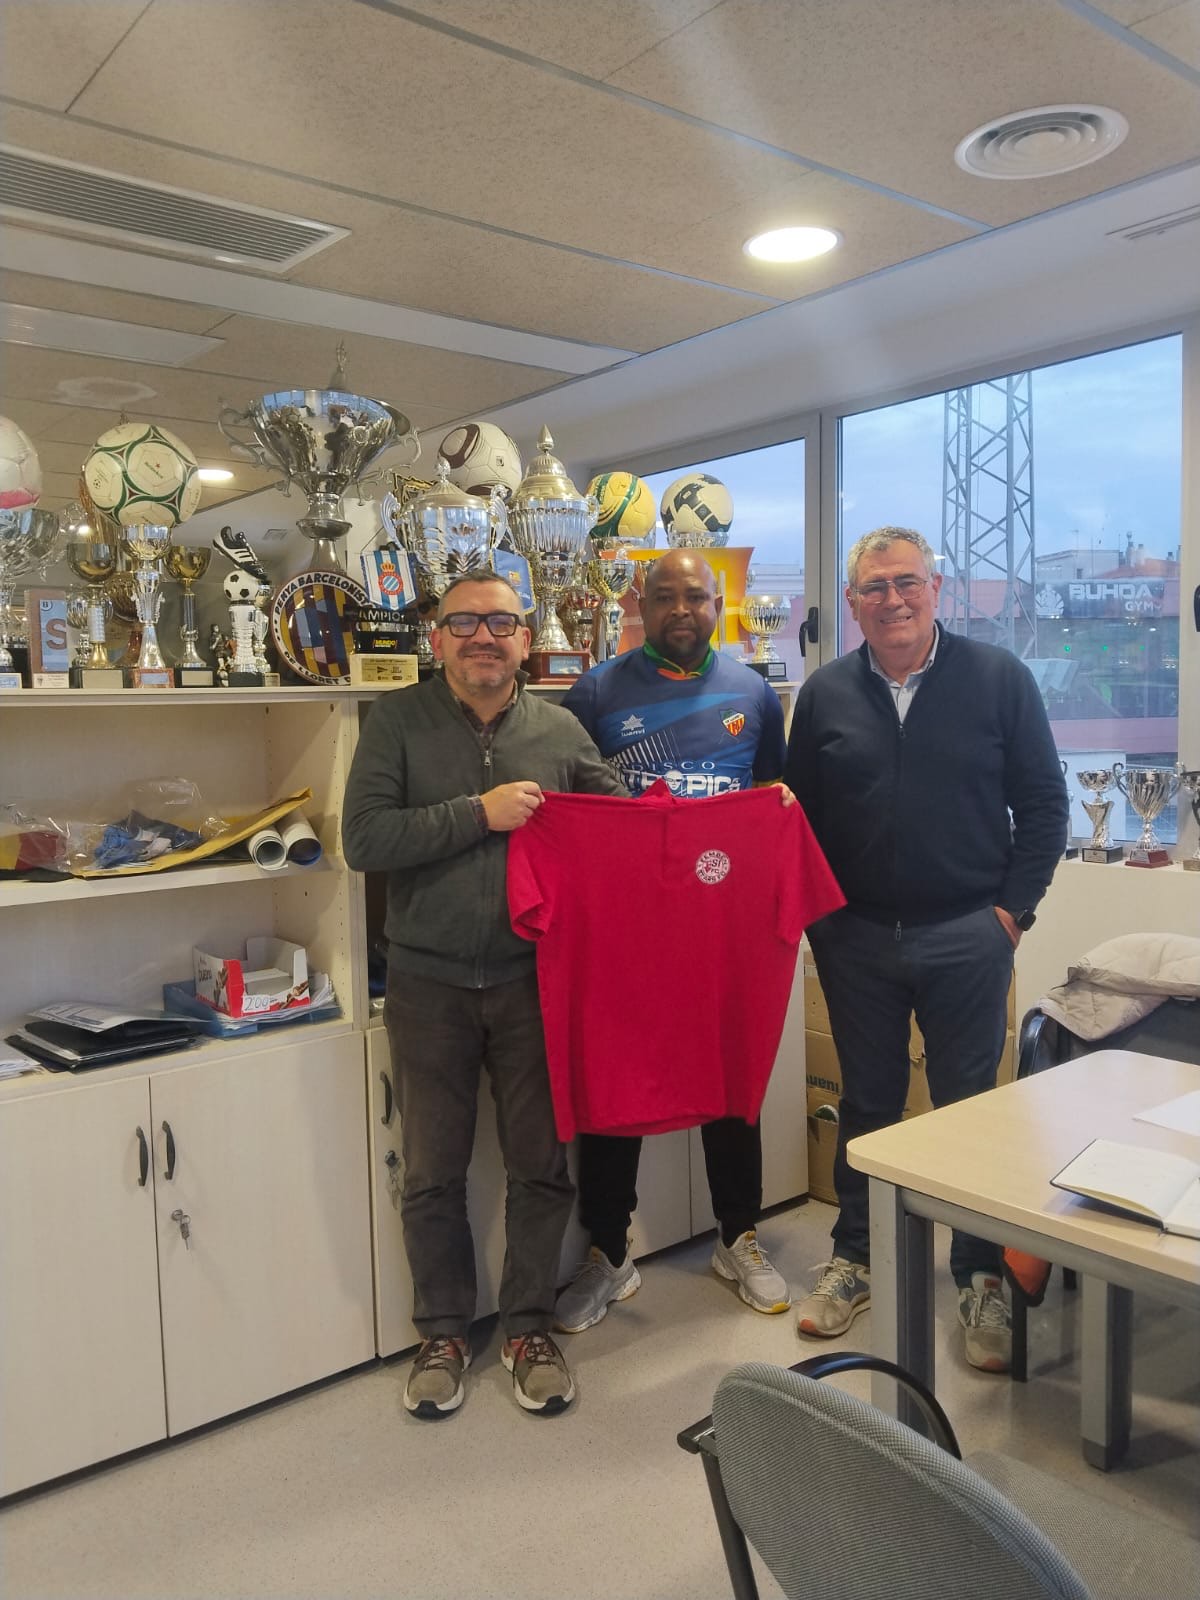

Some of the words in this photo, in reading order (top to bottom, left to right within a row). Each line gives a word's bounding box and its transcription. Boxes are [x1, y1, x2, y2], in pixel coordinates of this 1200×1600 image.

[275, 583, 298, 616] PENYA
[1125, 601, 1155, 612] GYM
[631, 761, 715, 771] DISCO
